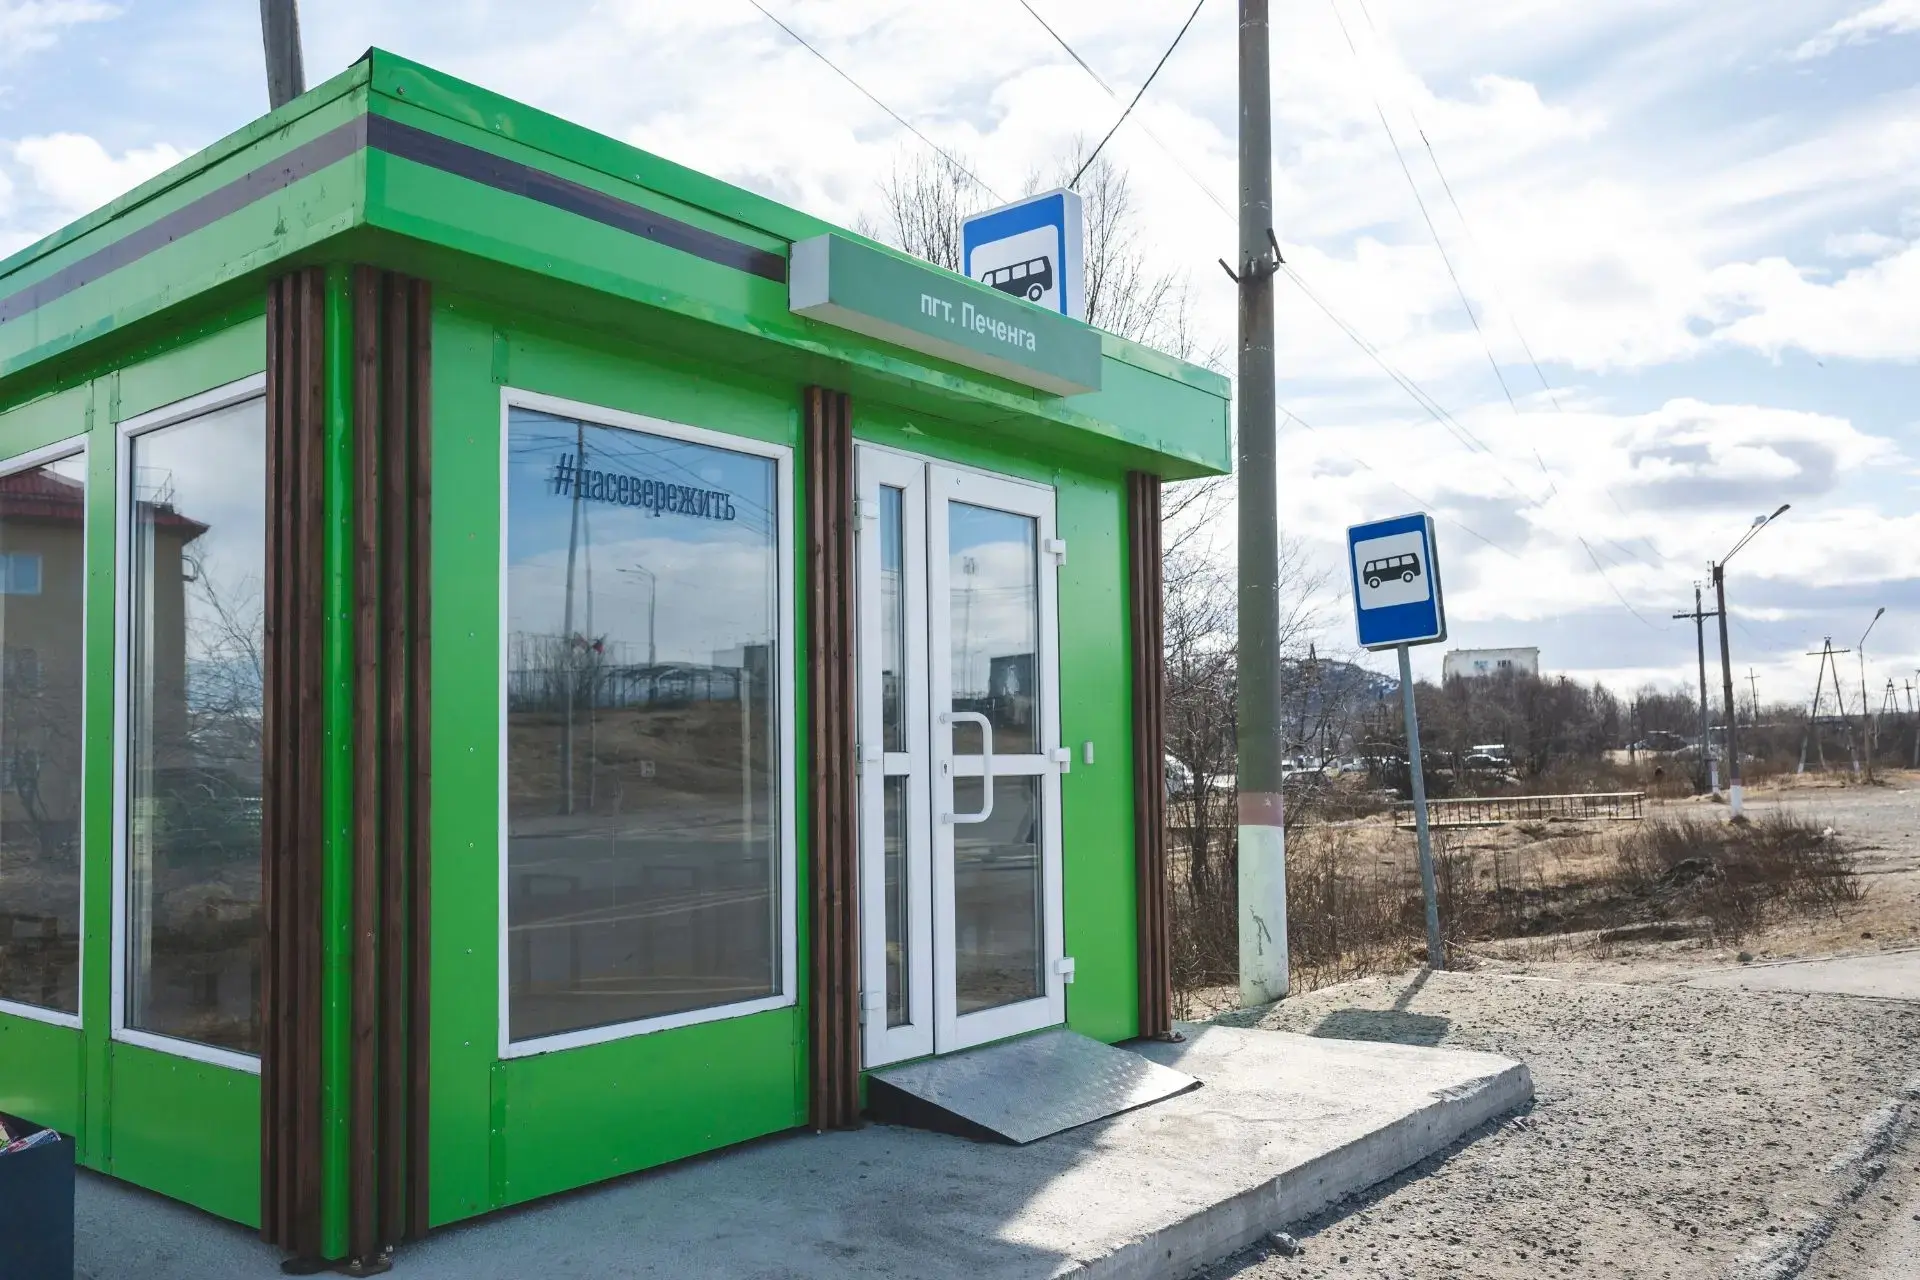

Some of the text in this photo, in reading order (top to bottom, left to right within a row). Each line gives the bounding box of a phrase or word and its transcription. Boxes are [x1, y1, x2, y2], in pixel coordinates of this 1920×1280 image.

[920, 293, 1036, 351] пгт. Печенга
[554, 453, 736, 521] #насевережить
